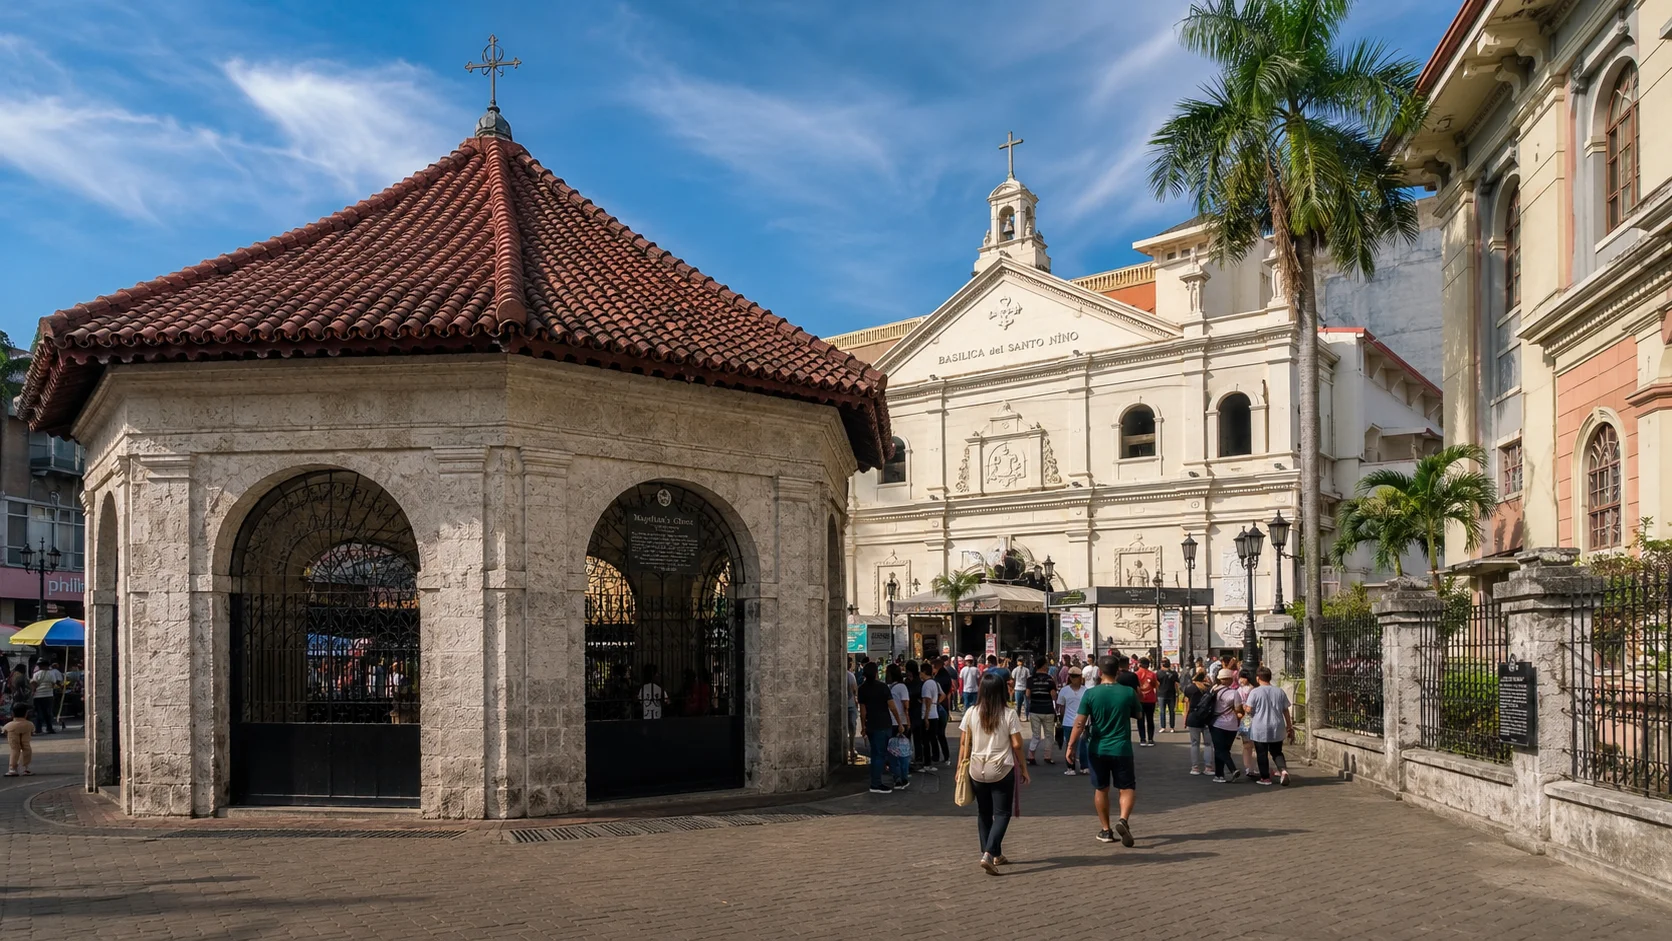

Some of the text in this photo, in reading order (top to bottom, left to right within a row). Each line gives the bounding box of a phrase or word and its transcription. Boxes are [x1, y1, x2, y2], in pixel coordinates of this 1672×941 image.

[938, 350, 985, 365] BASILICA
[989, 345, 1004, 356] del
[1008, 338, 1045, 352] SANTO
